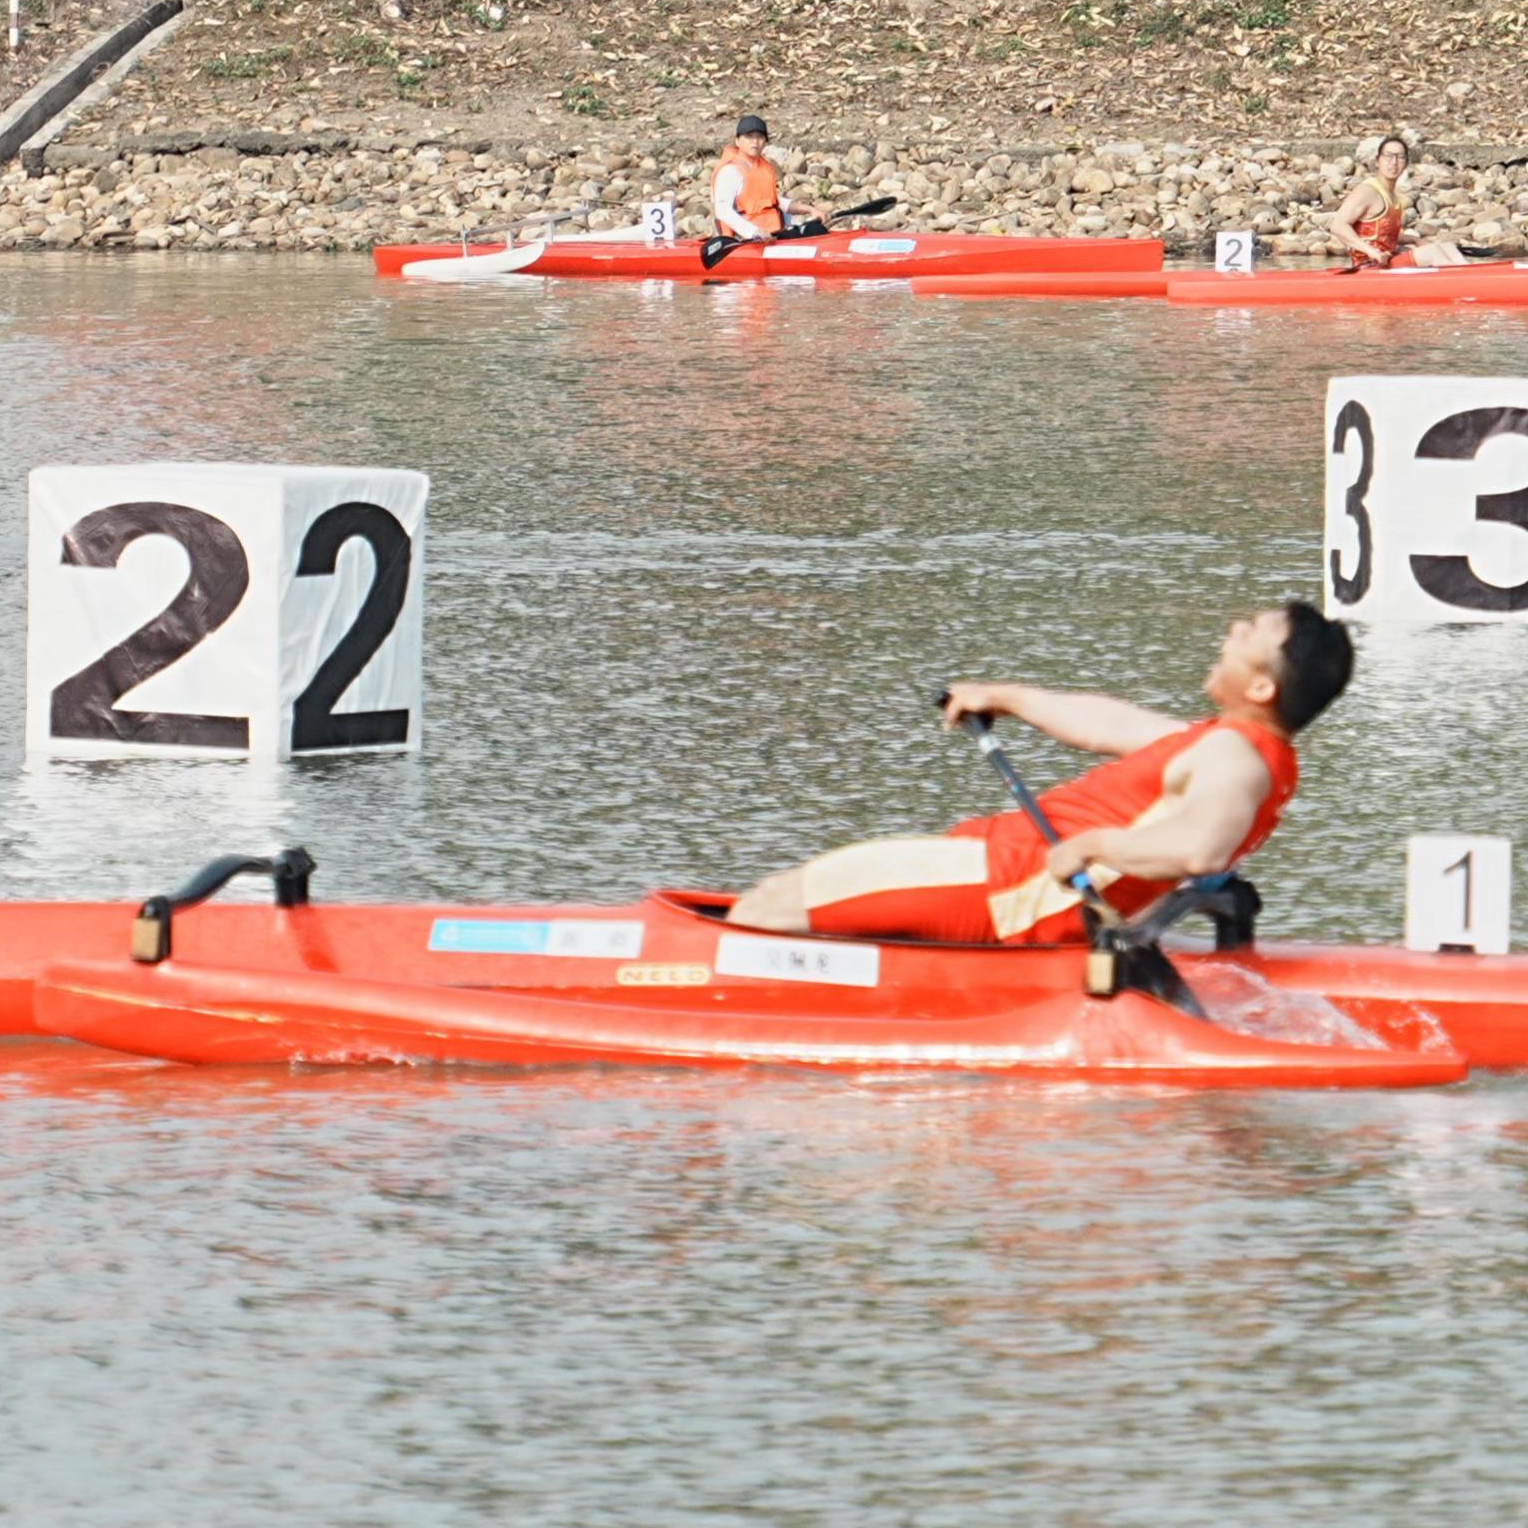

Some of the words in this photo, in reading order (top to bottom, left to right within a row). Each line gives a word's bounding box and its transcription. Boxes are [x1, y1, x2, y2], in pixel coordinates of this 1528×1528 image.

[651, 208, 666, 235] 3
[1224, 239, 1243, 267] 2
[1331, 400, 1374, 605] 3
[51, 501, 250, 749] 2
[291, 501, 412, 752] 2
[1441, 849, 1473, 933] 1
